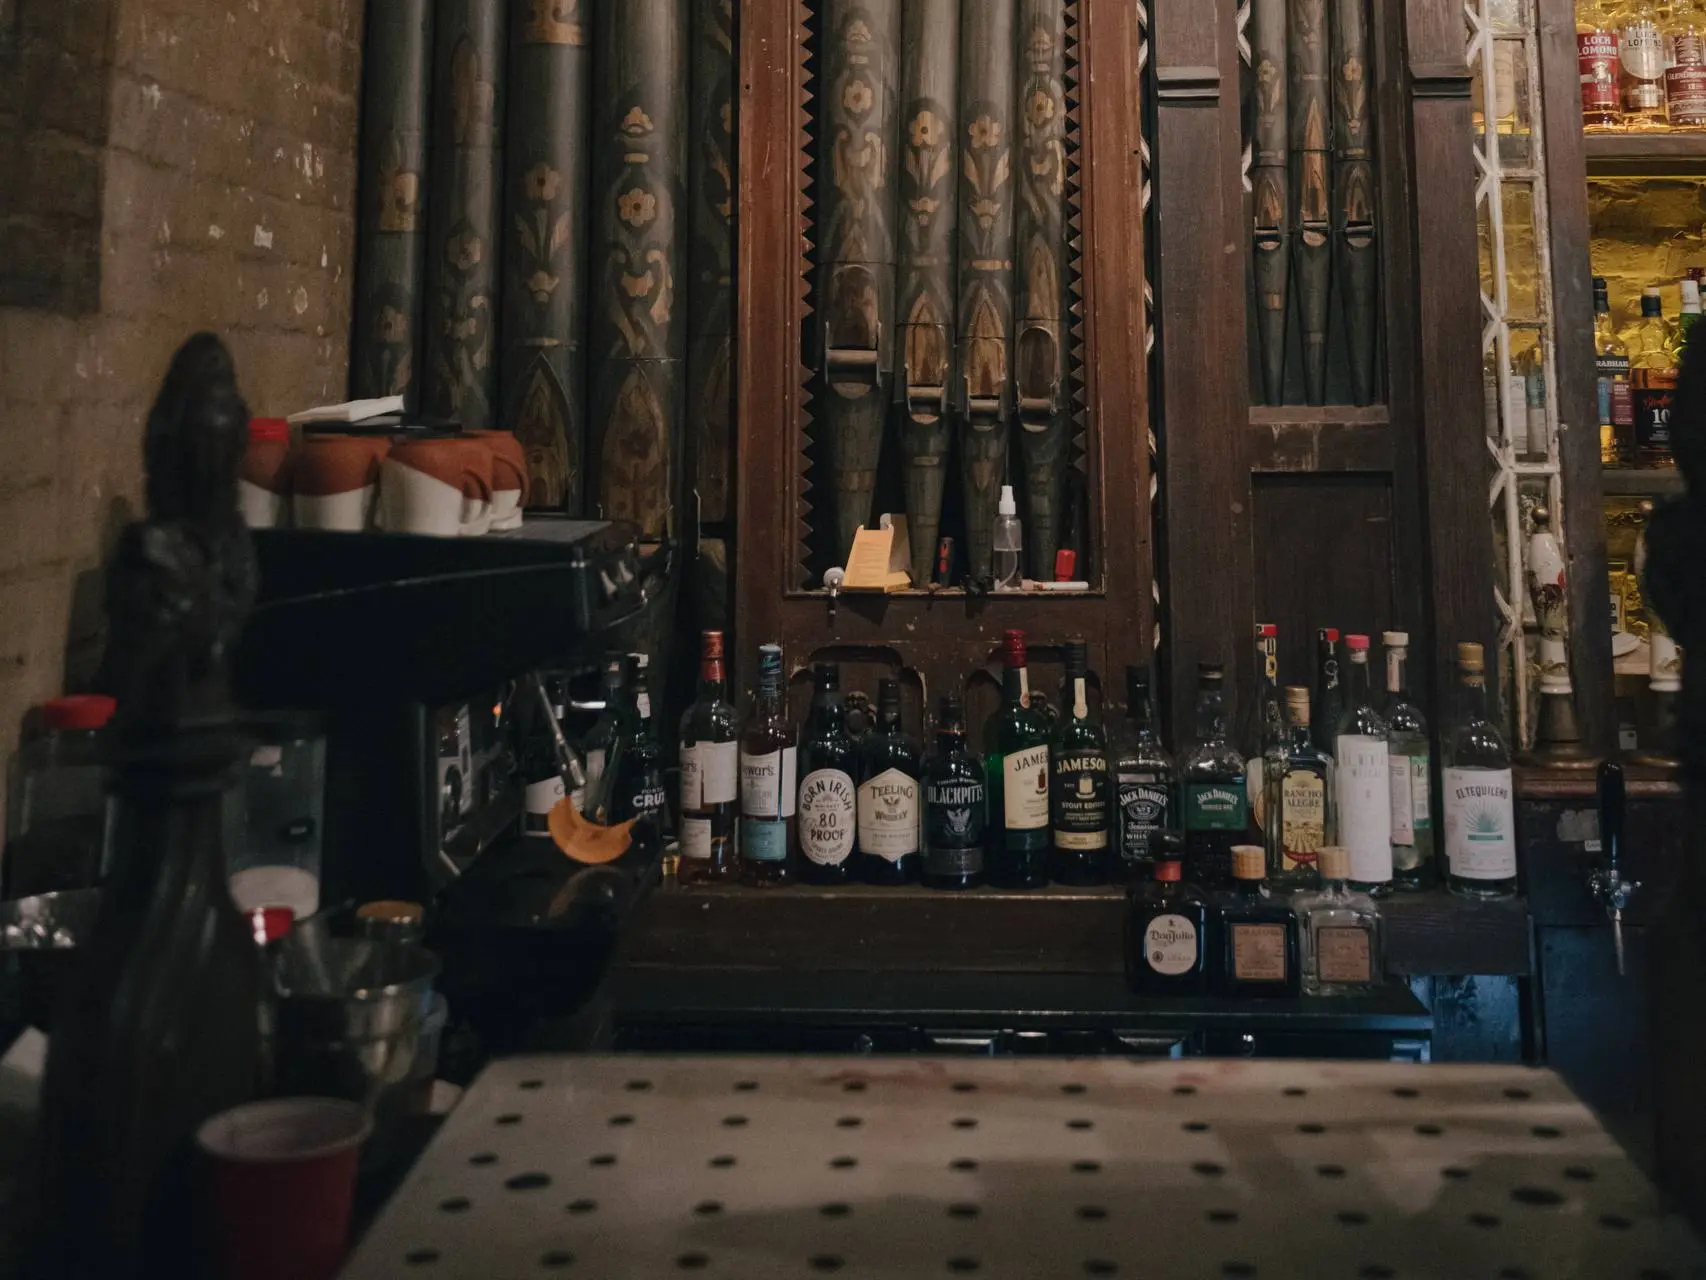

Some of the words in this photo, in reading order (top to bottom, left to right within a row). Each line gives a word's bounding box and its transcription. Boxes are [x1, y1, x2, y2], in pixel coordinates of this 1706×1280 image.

[1584, 36, 1612, 46] LOCH
[1577, 46, 1618, 56] LOMOND
[803, 780, 825, 812] BORN
[829, 780, 853, 811] IRISH
[870, 784, 913, 799] TEELING
[1120, 790, 1138, 807] JACK
[1196, 791, 1213, 805] JACK
[1284, 788, 1322, 798] RANCHO
[819, 812, 837, 828] 80
[810, 828, 845, 841] PROOF
